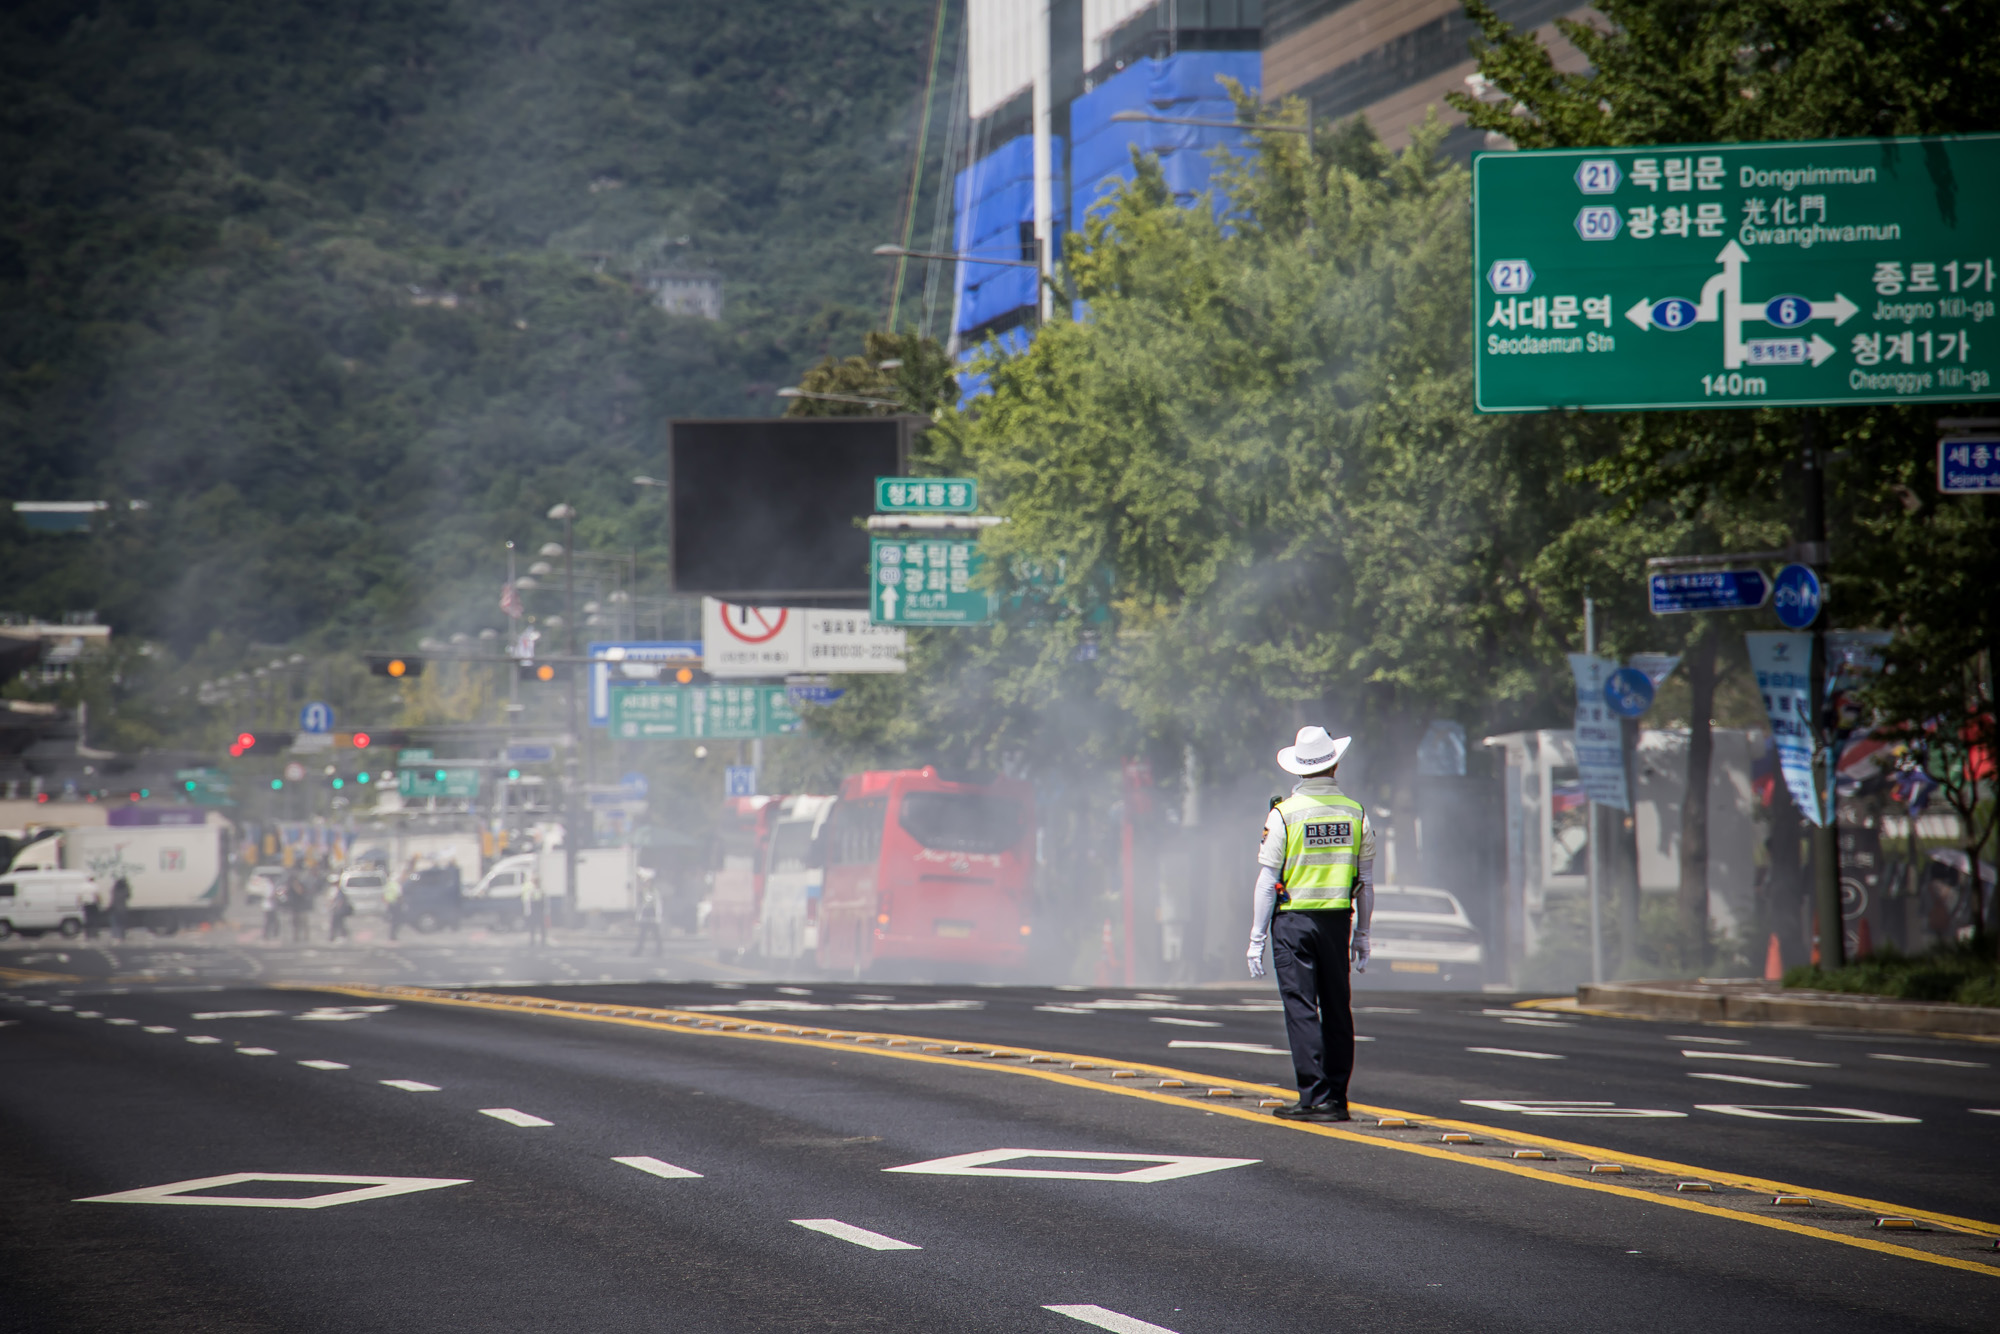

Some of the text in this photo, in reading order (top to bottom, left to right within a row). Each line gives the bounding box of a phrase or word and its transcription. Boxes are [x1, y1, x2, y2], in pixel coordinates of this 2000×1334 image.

[1588, 156, 1876, 192] 21 독립문 Dongnimmun
[1586, 203, 1727, 239] 50 광화문
[1740, 194, 1827, 226] 光化門
[1739, 222, 1901, 249] Gwanghwamun
[1500, 265, 1524, 288] 21
[1871, 257, 1997, 296] 종로1가
[1487, 294, 1612, 330] 서대문역
[1664, 301, 1683, 326] 6
[1779, 298, 1797, 325] 6
[1872, 300, 1935, 324] Jongno
[1487, 331, 1615, 355] Seodaemun Stn
[1850, 329, 1971, 366] 청계1가
[1701, 373, 1767, 396] 140m
[1849, 368, 1934, 394] Cheonggye
[904, 544, 970, 568] 독립문
[1308, 824, 1348, 836] 교통경찰
[1309, 837, 1347, 845] POLICE
